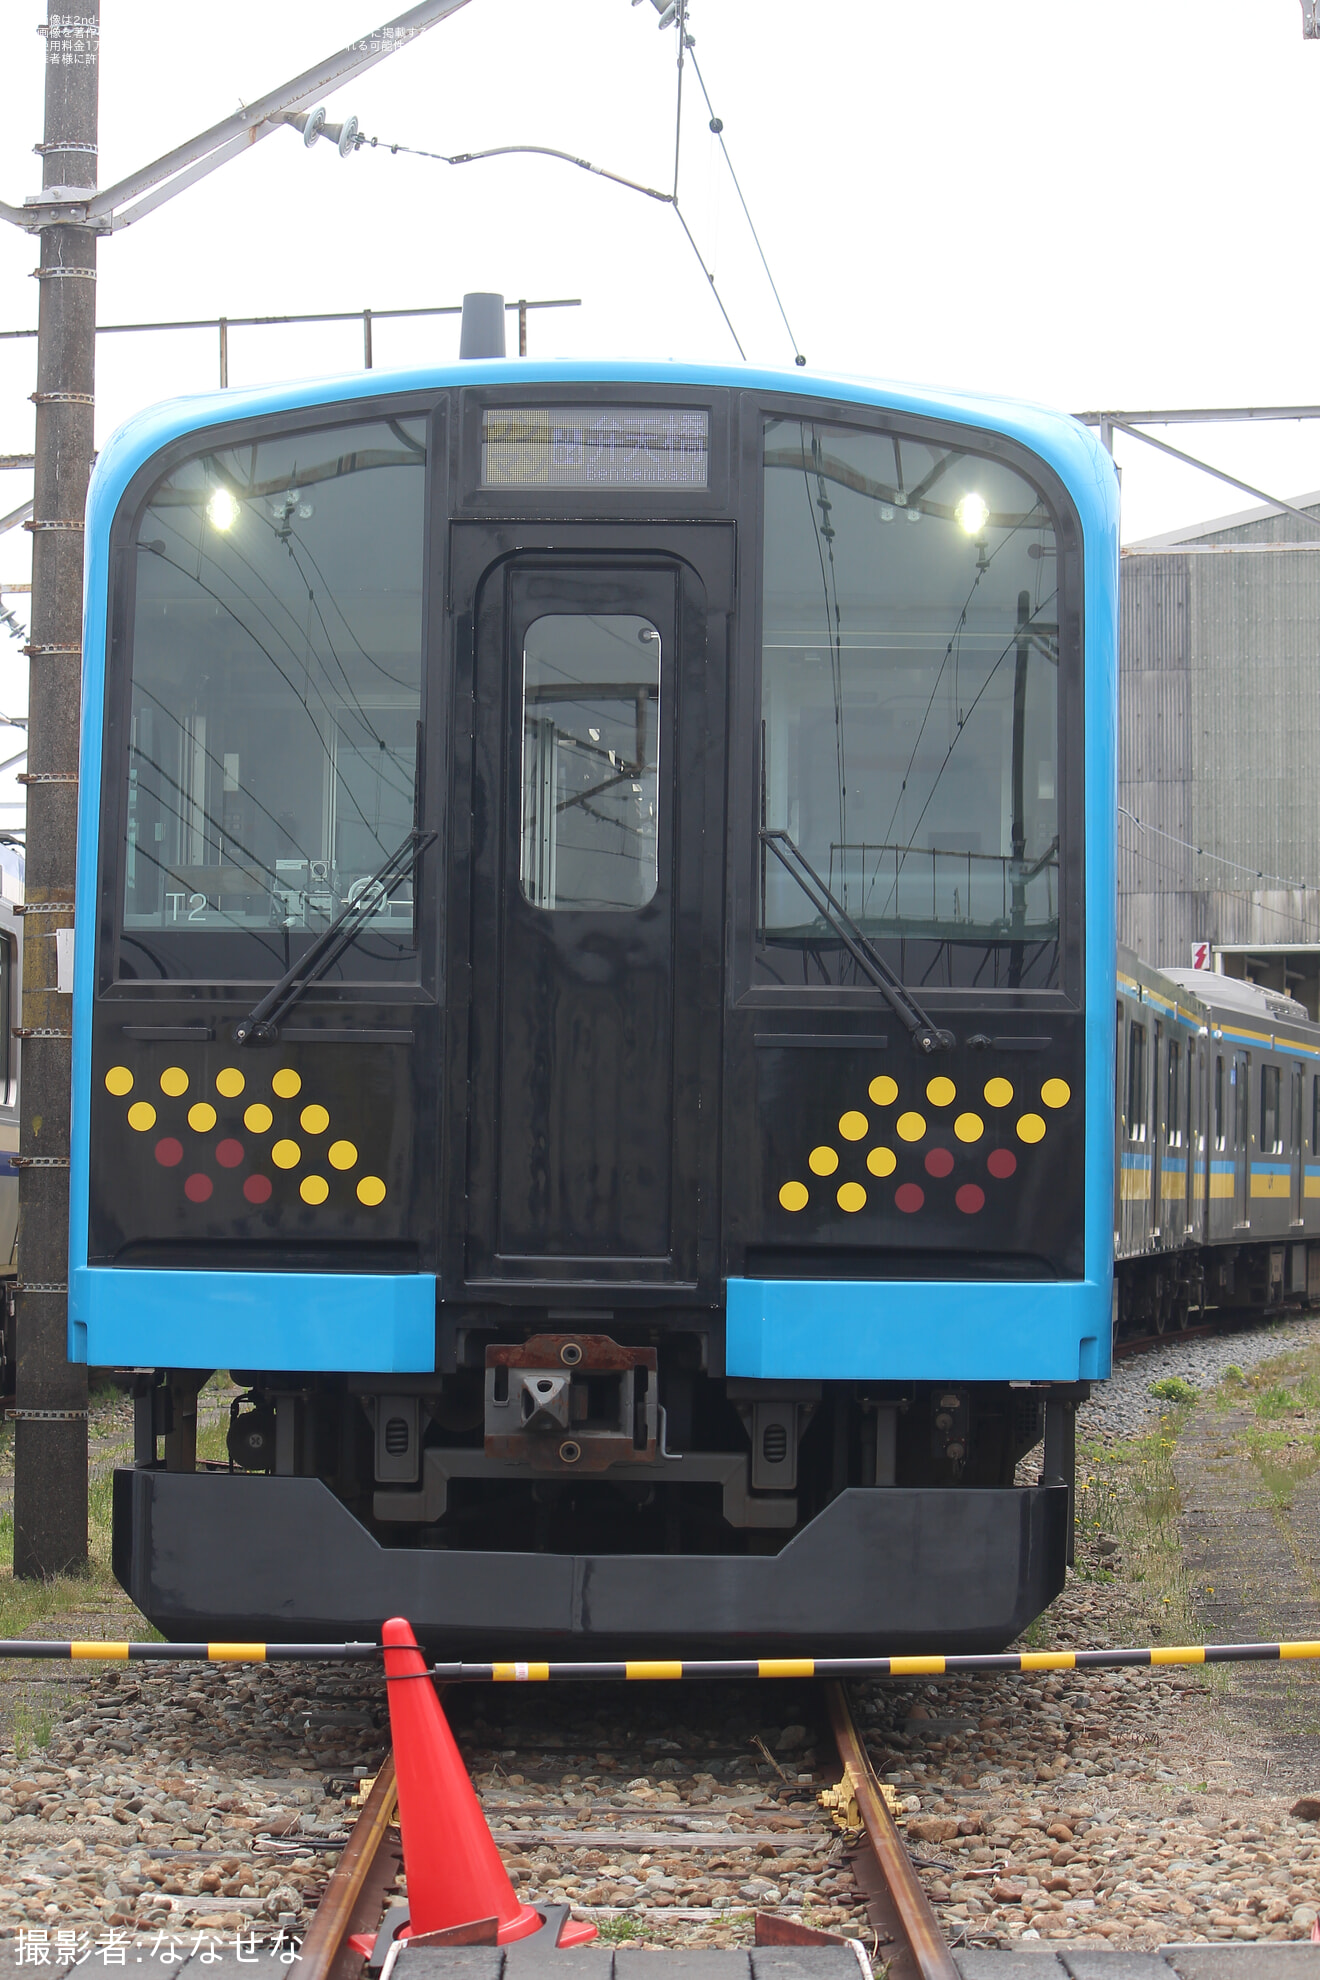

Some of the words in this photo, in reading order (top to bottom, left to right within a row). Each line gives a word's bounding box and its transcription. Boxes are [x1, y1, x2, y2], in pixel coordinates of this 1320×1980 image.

[588, 415, 705, 463] 弁天橋
[587, 464, 706, 481] Bentembashi
[165, 892, 208, 921] T2
